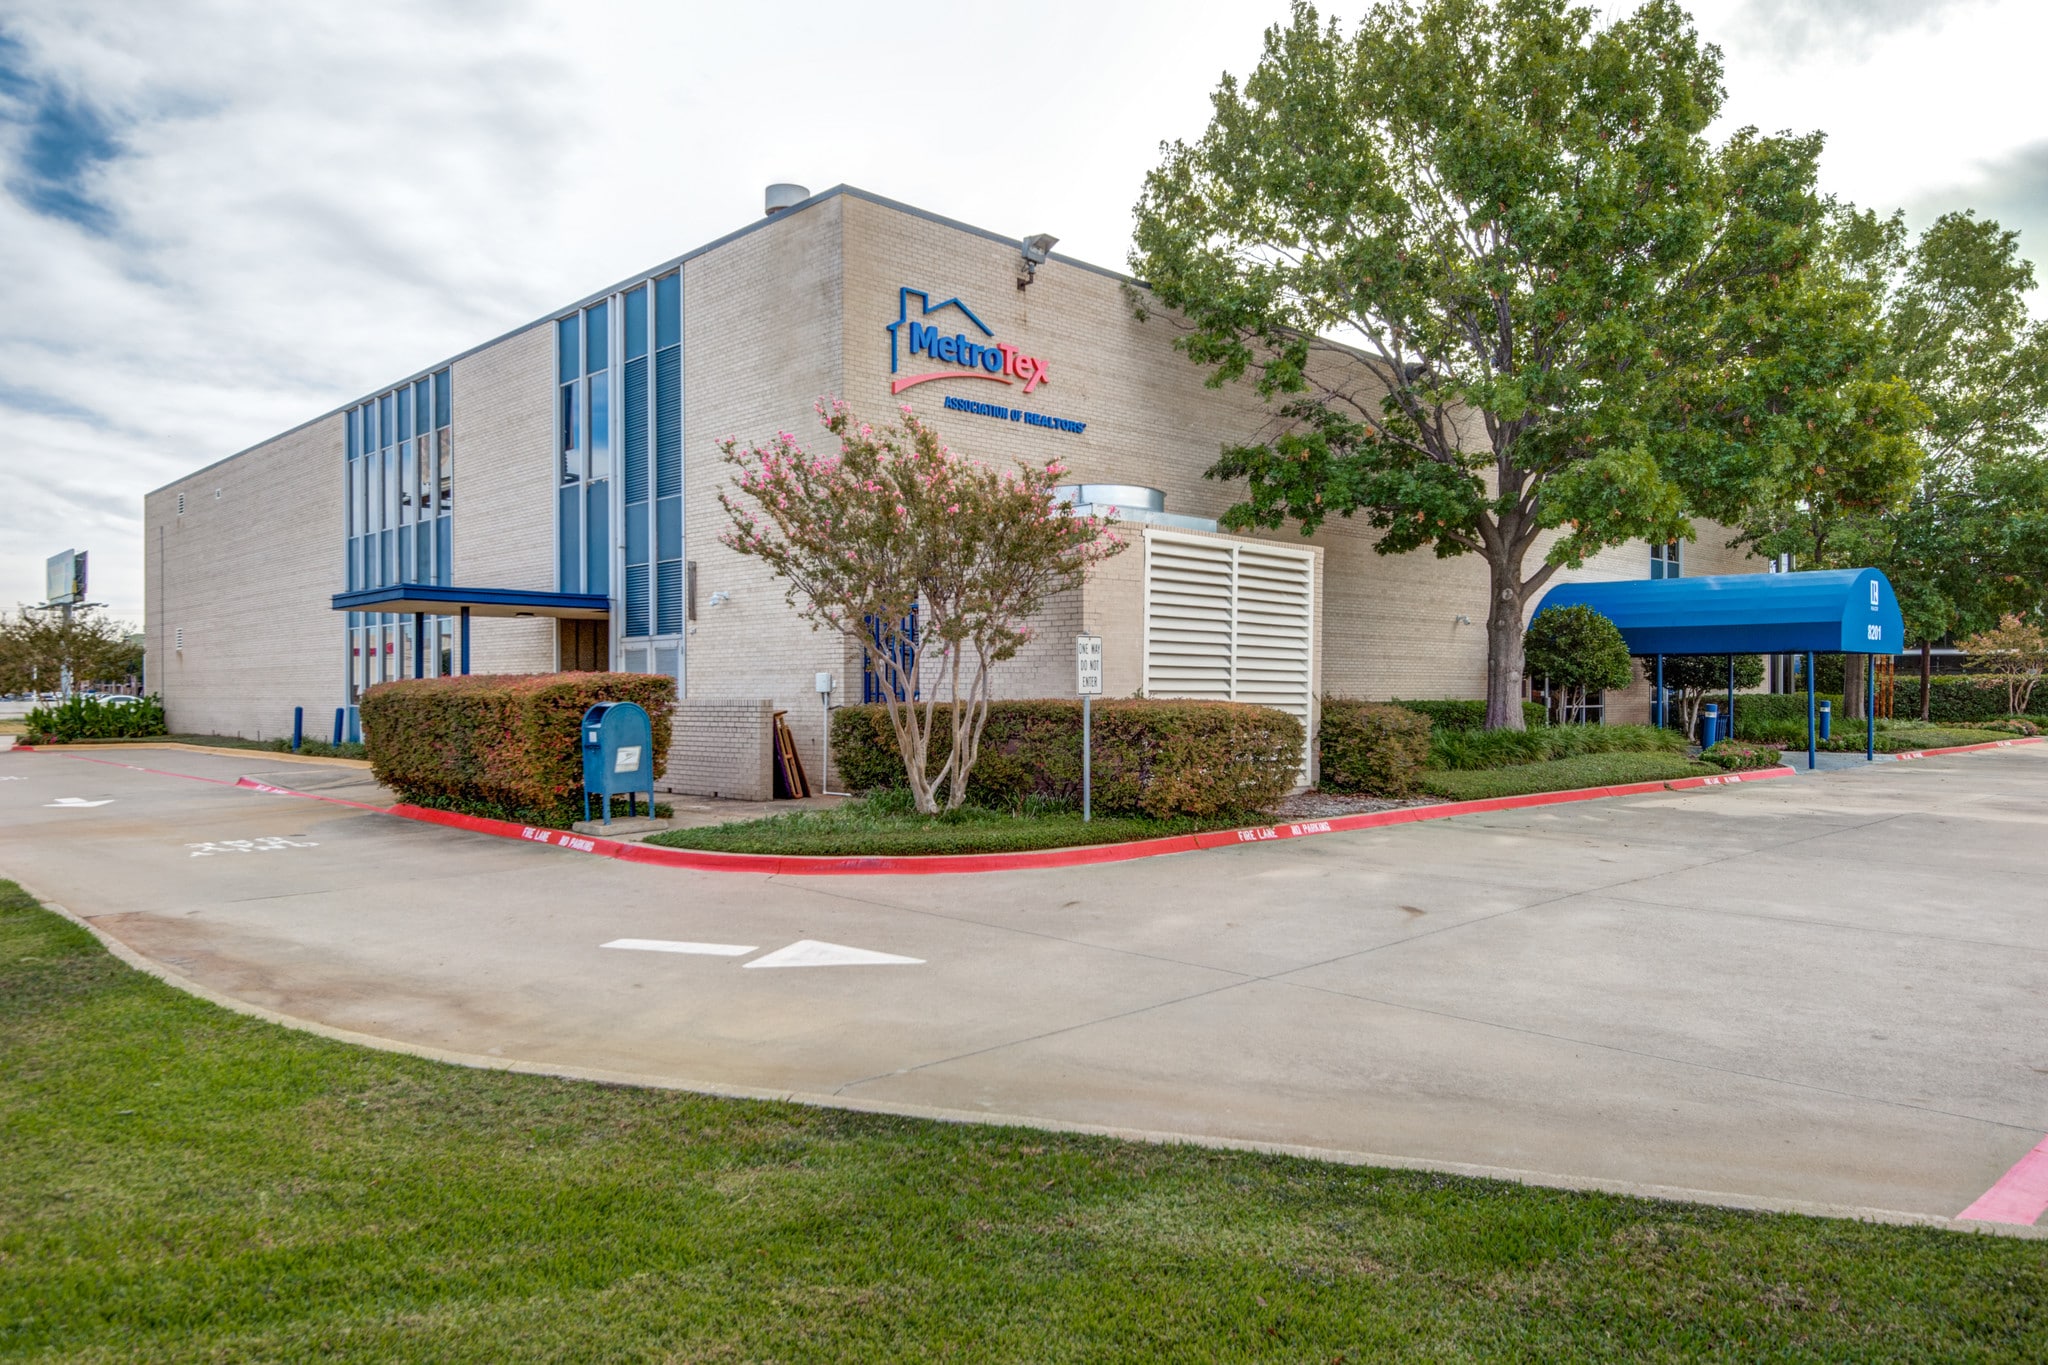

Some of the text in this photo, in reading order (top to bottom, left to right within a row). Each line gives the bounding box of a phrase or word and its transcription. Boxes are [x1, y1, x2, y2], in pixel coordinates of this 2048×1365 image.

[909, 321, 1049, 393] MetroTex
[944, 396, 1009, 420] ASSOCIATION
[1010, 409, 1022, 422] OF
[1867, 624, 1882, 641] 8201
[1079, 643, 1100, 654] ONE WAY
[1080, 659, 1099, 671] DO NOT
[1082, 676, 1098, 687] ENTER
[1238, 821, 1331, 841] FIRE LANE NO PARKING
[558, 835, 571, 847] NO
